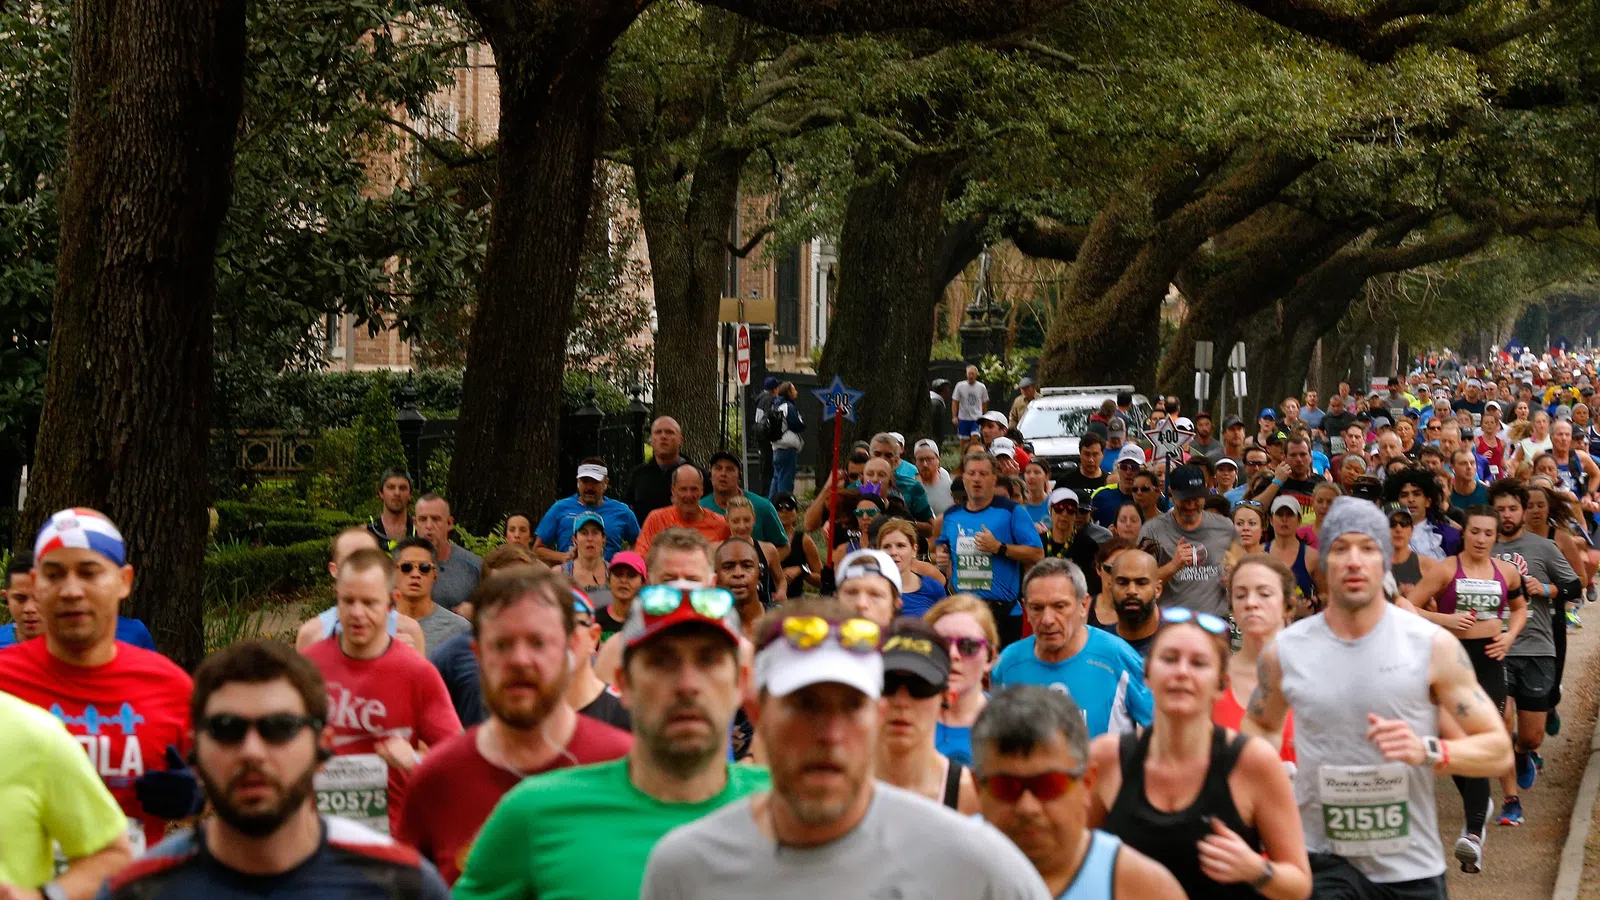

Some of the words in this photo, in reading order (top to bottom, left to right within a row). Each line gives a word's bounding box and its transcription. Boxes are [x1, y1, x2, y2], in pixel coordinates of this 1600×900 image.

[1457, 594, 1501, 607] 21420
[316, 790, 387, 812] 20575
[1327, 804, 1404, 831] 21516
